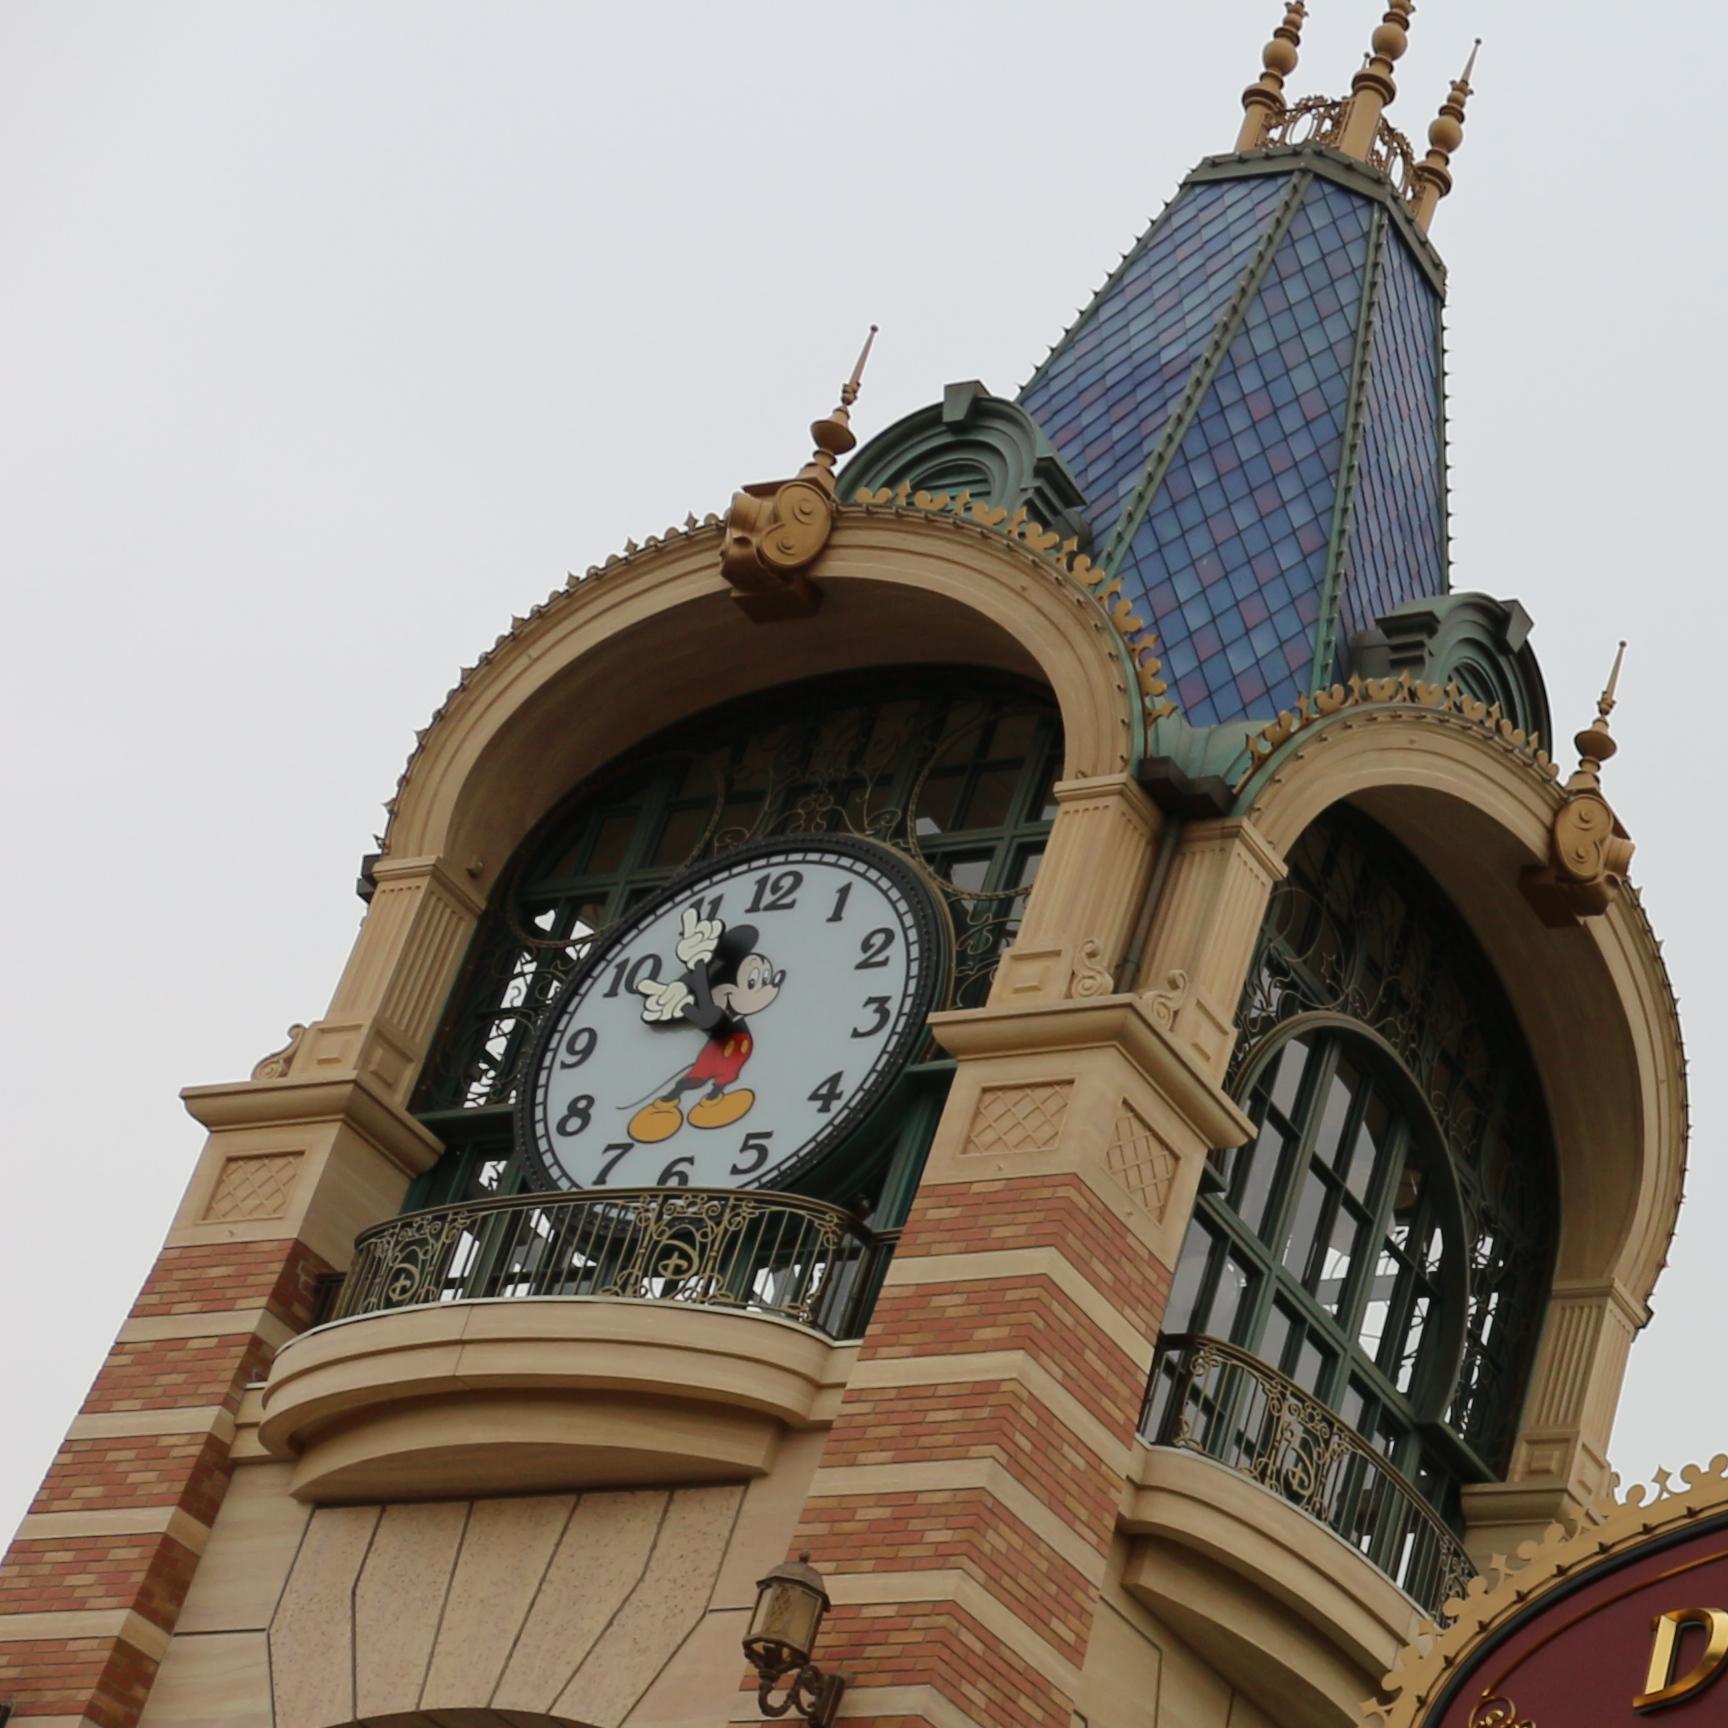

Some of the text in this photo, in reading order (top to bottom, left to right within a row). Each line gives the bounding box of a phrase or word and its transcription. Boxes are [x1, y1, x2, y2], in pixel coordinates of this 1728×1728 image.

[744, 870, 804, 914] 12
[826, 882, 853, 923] 1
[854, 927, 895, 970] 2
[602, 953, 662, 999] 10
[851, 996, 892, 1039] 3
[560, 1027, 598, 1070] 9
[808, 1071, 844, 1114] 4
[556, 1094, 595, 1137] 8
[592, 1142, 635, 1186] 7
[657, 1156, 695, 1187] 6
[730, 1131, 774, 1176] 5
